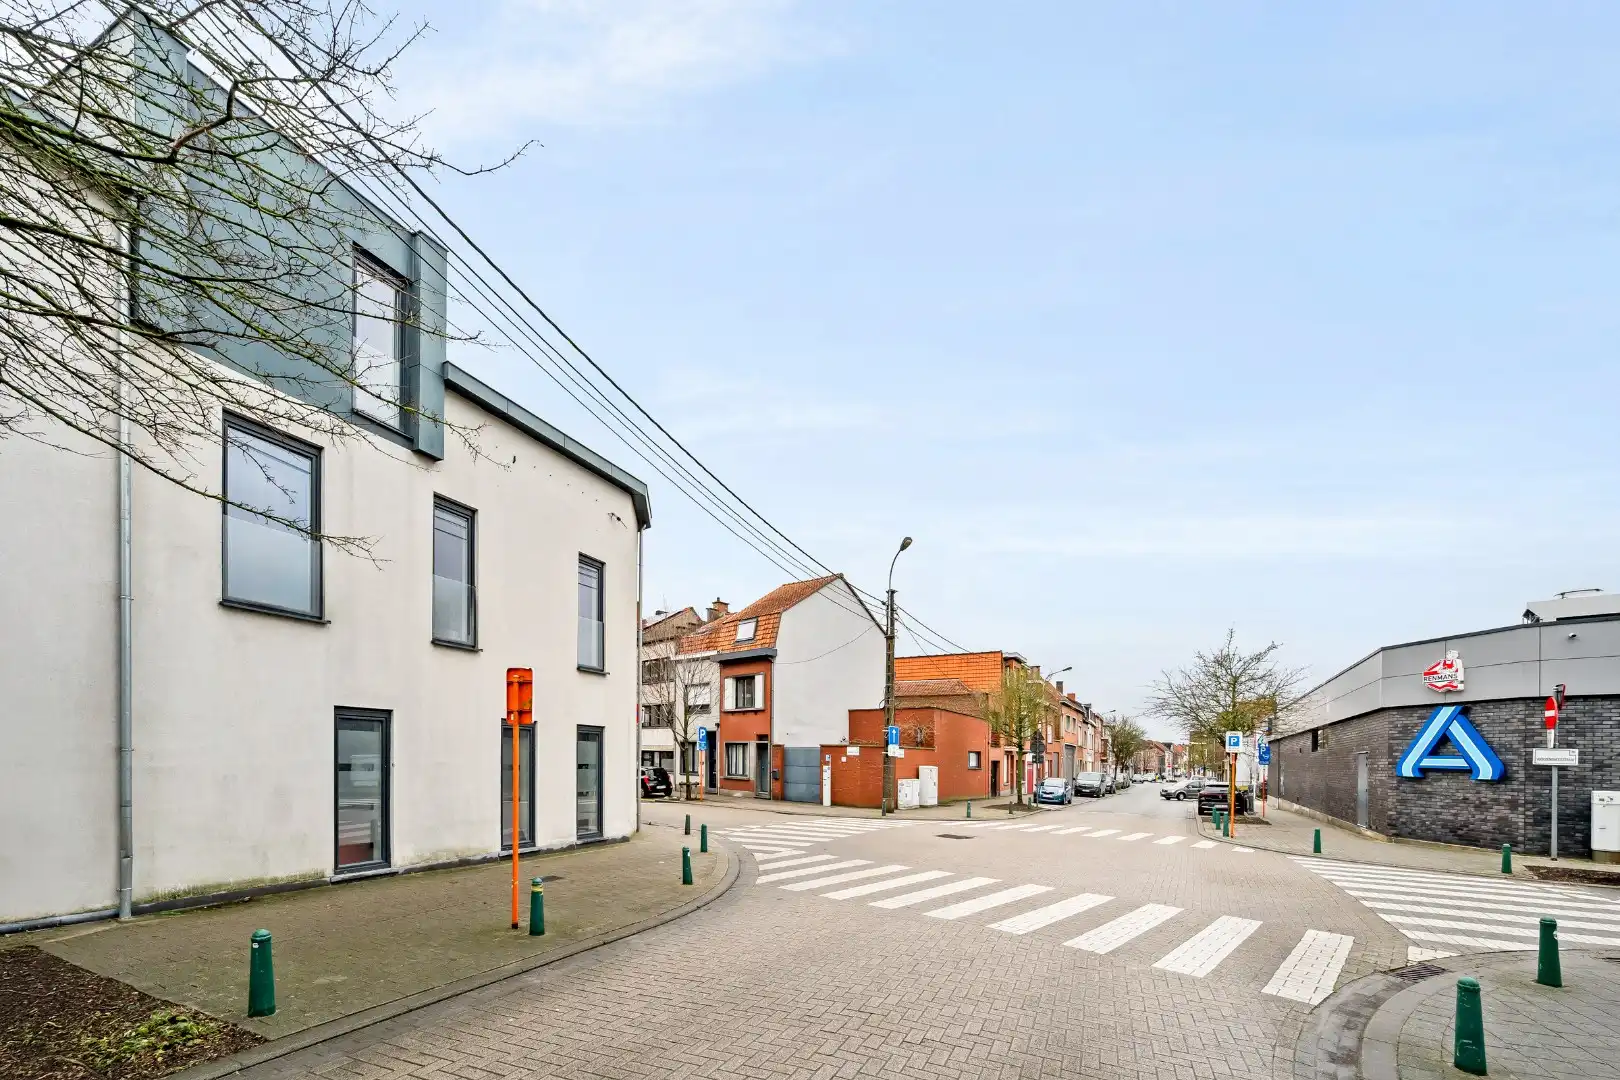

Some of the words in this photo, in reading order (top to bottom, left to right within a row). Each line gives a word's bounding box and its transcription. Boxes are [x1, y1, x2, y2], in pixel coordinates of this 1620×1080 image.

[1423, 674, 1458, 682] RENMANS
[700, 729, 705, 739] P
[1230, 737, 1237, 745] P
[1260, 746, 1266, 755] P
